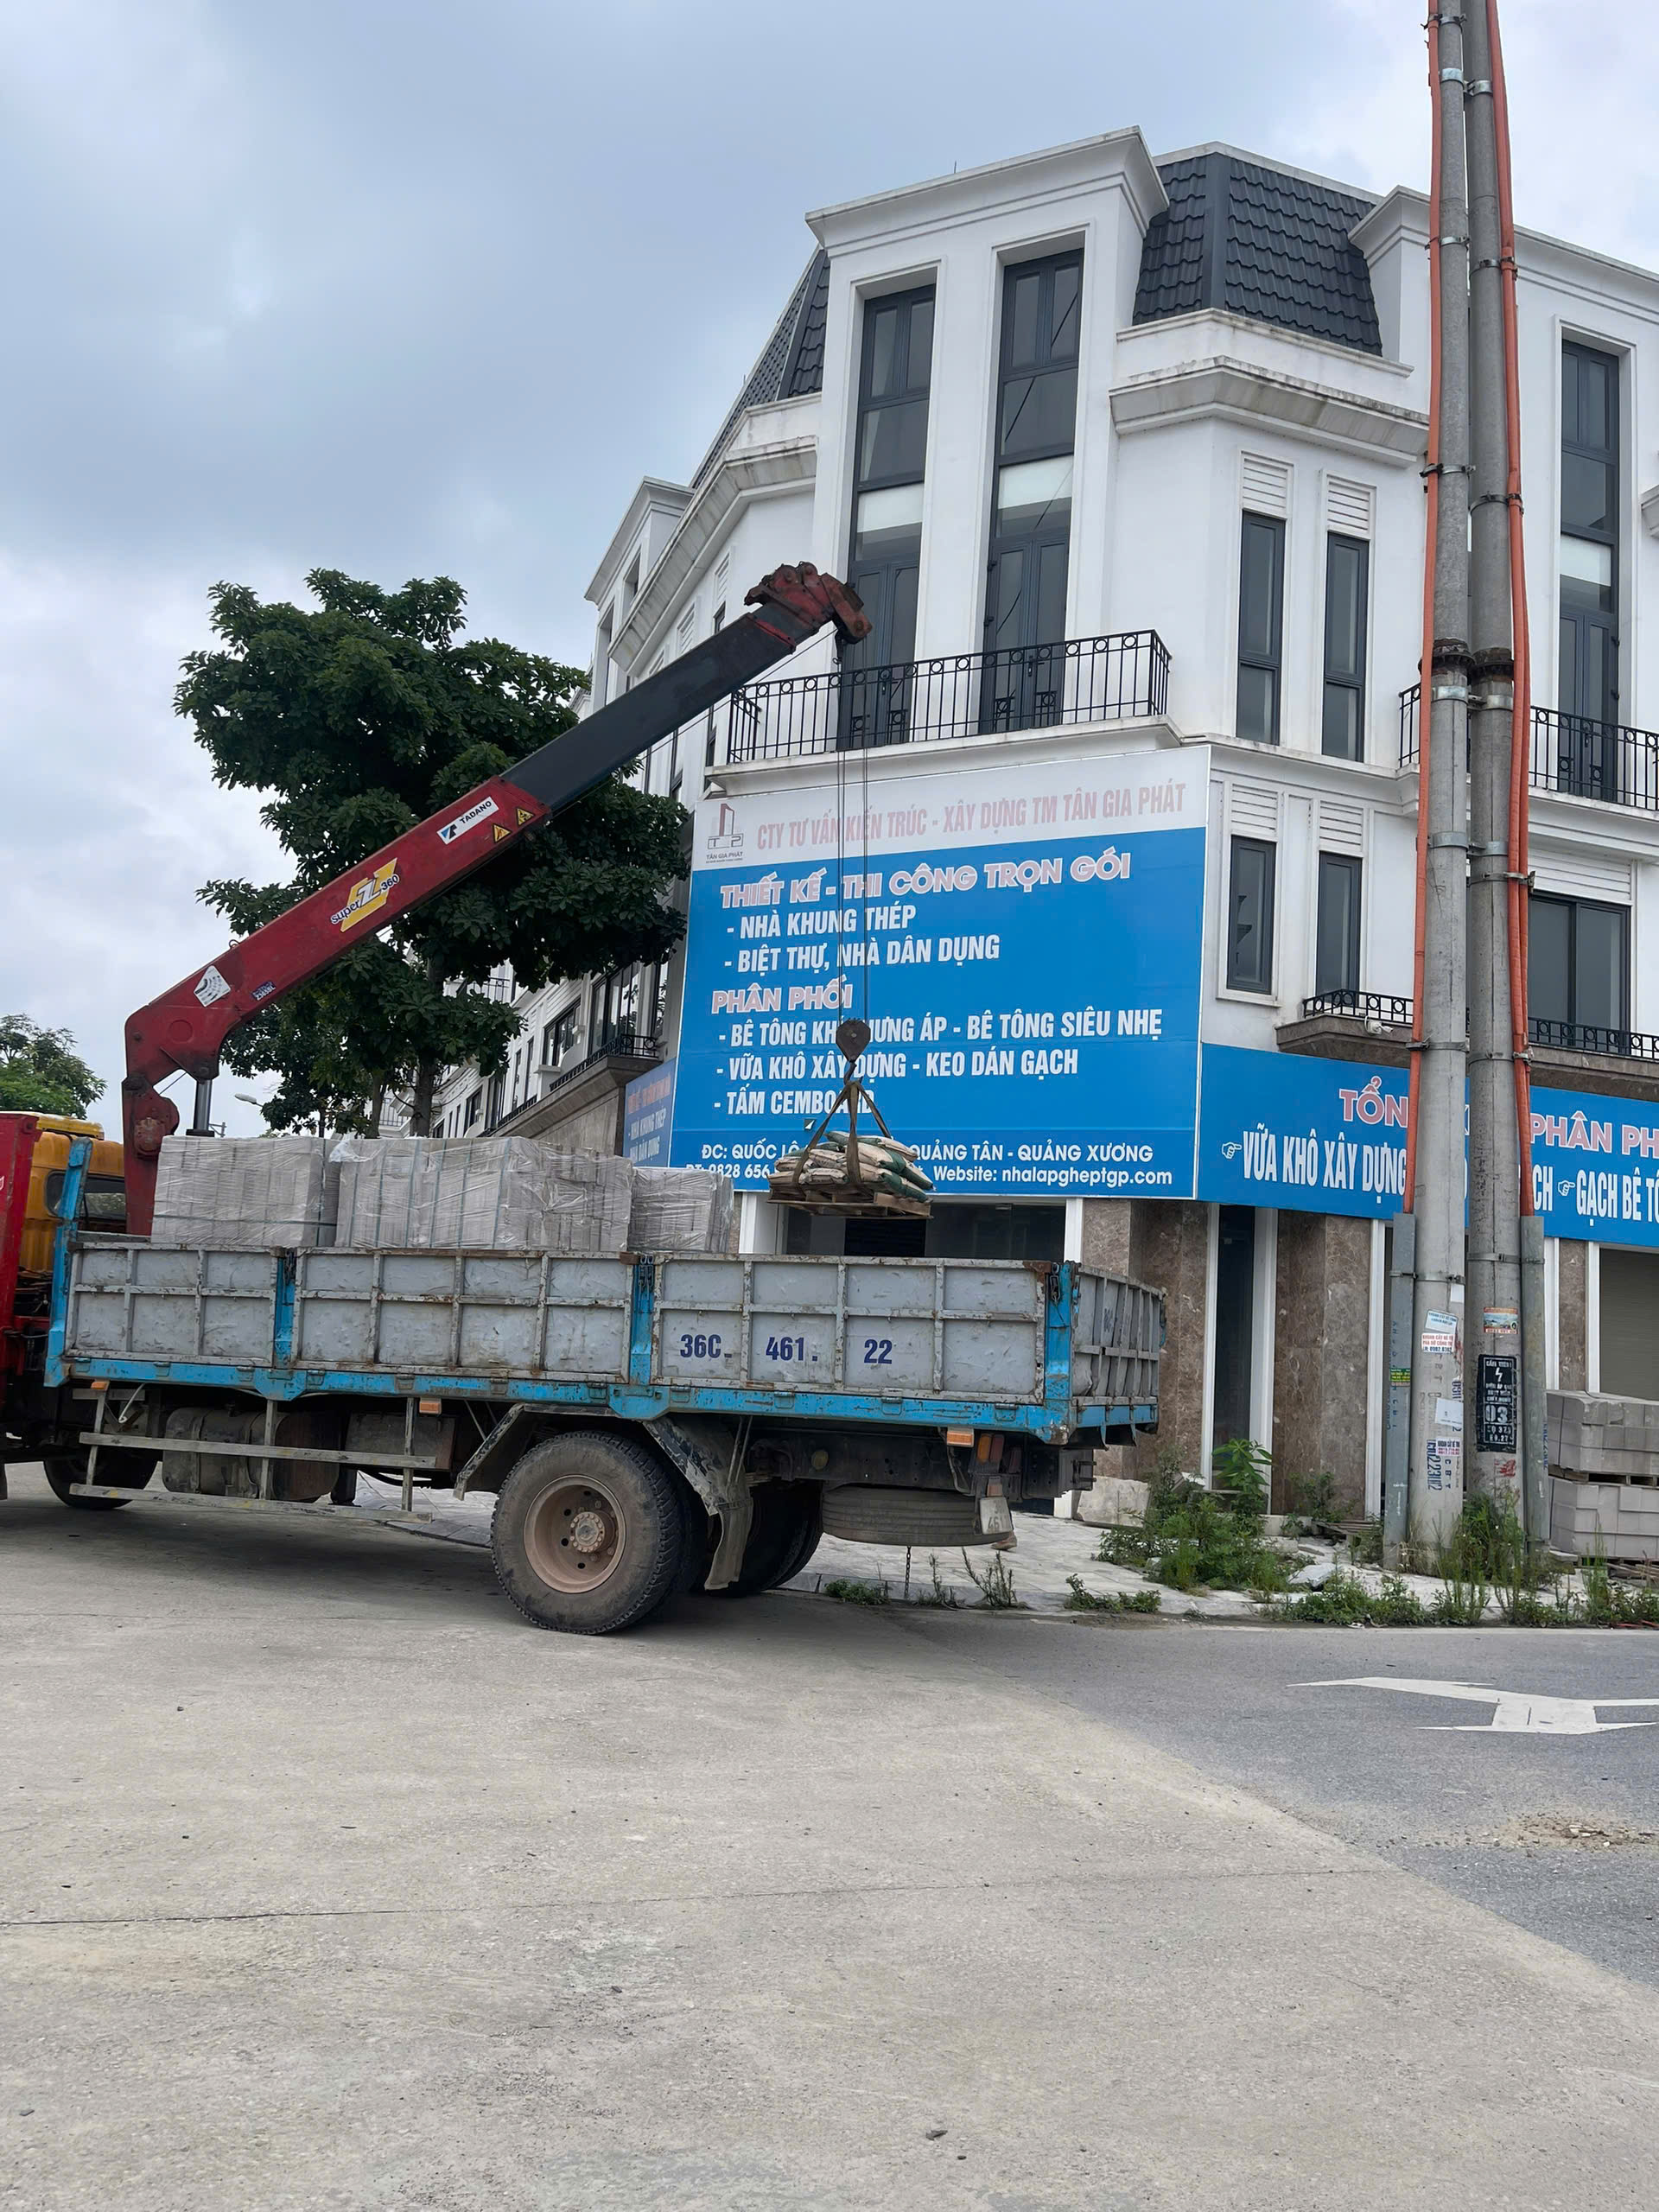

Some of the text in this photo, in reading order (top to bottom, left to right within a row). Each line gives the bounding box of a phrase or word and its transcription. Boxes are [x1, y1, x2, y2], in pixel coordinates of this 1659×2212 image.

[460, 800, 492, 824] TADANO
[758, 823, 785, 850] CTY
[789, 817, 809, 847] TƯ
[810, 808, 841, 845] VẤN
[845, 805, 882, 842] KIẾN
[887, 804, 927, 838] TRÚC
[943, 799, 976, 833] XÂY
[980, 798, 1027, 834] DỰNG
[1033, 795, 1058, 823] TM
[1063, 787, 1097, 821] TÂN
[1103, 789, 1132, 818] GIA
[1138, 778, 1185, 815] PHÁT
[721, 871, 785, 909] THIẾT
[790, 868, 827, 903] KẾ
[842, 873, 882, 899] THI
[888, 862, 977, 895] CÔNG
[984, 857, 1063, 893] TRỌN
[1071, 846, 1131, 882] GÓI
[331, 899, 360, 925] super
[380, 874, 399, 893] 360
[740, 910, 781, 939] NHÀ
[786, 909, 857, 936] KHUNG
[865, 900, 917, 931] THÉP
[737, 944, 781, 976] BIỆT
[786, 943, 830, 974] THỰ,
[836, 938, 880, 967] NHÀ
[887, 935, 931, 964] DÂN
[938, 934, 1000, 966] DỤNG
[711, 974, 854, 1014] PHÂN PHỐI
[731, 1020, 753, 1046] BÊ
[760, 1018, 806, 1046] TÔNG
[811, 1015, 844, 1044] KH
[868, 1016, 914, 1043] ƯNG
[919, 1012, 947, 1042] ÁP
[967, 1009, 993, 1040] BÊ
[1000, 1008, 1054, 1039] TÔNG
[1061, 1006, 1111, 1037] SIÊU
[1117, 1008, 1163, 1041] NHẸ
[729, 1052, 763, 1081] VỮA
[768, 1051, 806, 1079] KHÔ
[811, 1050, 848, 1079] XÂY
[854, 1051, 906, 1084] DỰNG
[926, 1052, 965, 1077] KEO
[971, 1046, 1014, 1077] DÁN
[1020, 1048, 1078, 1080] GẠCH
[727, 1084, 765, 1115] TẤM
[1338, 1076, 1408, 1128] TỔN
[702, 1144, 728, 1160] ĐC:
[732, 1137, 777, 1160] QUỐC
[971, 1141, 1003, 1160] TÂN
[1017, 1139, 1081, 1162] QUẢNG
[1086, 1141, 1154, 1162] XƯƠNG
[1530, 1110, 1612, 1154] PHÂN
[933, 1166, 998, 1182] Website:
[1002, 1166, 1173, 1188] nhalapgheptgp.com
[1243, 1122, 1277, 1182] VỮA
[1282, 1128, 1319, 1187] KHÔ
[1323, 1131, 1358, 1190] XÂY
[1362, 1141, 1407, 1204] DỰNG
[1576, 1169, 1618, 1226] GẠCH
[1622, 1166, 1642, 1221] BÊ
[863, 1338, 893, 1364] 22
